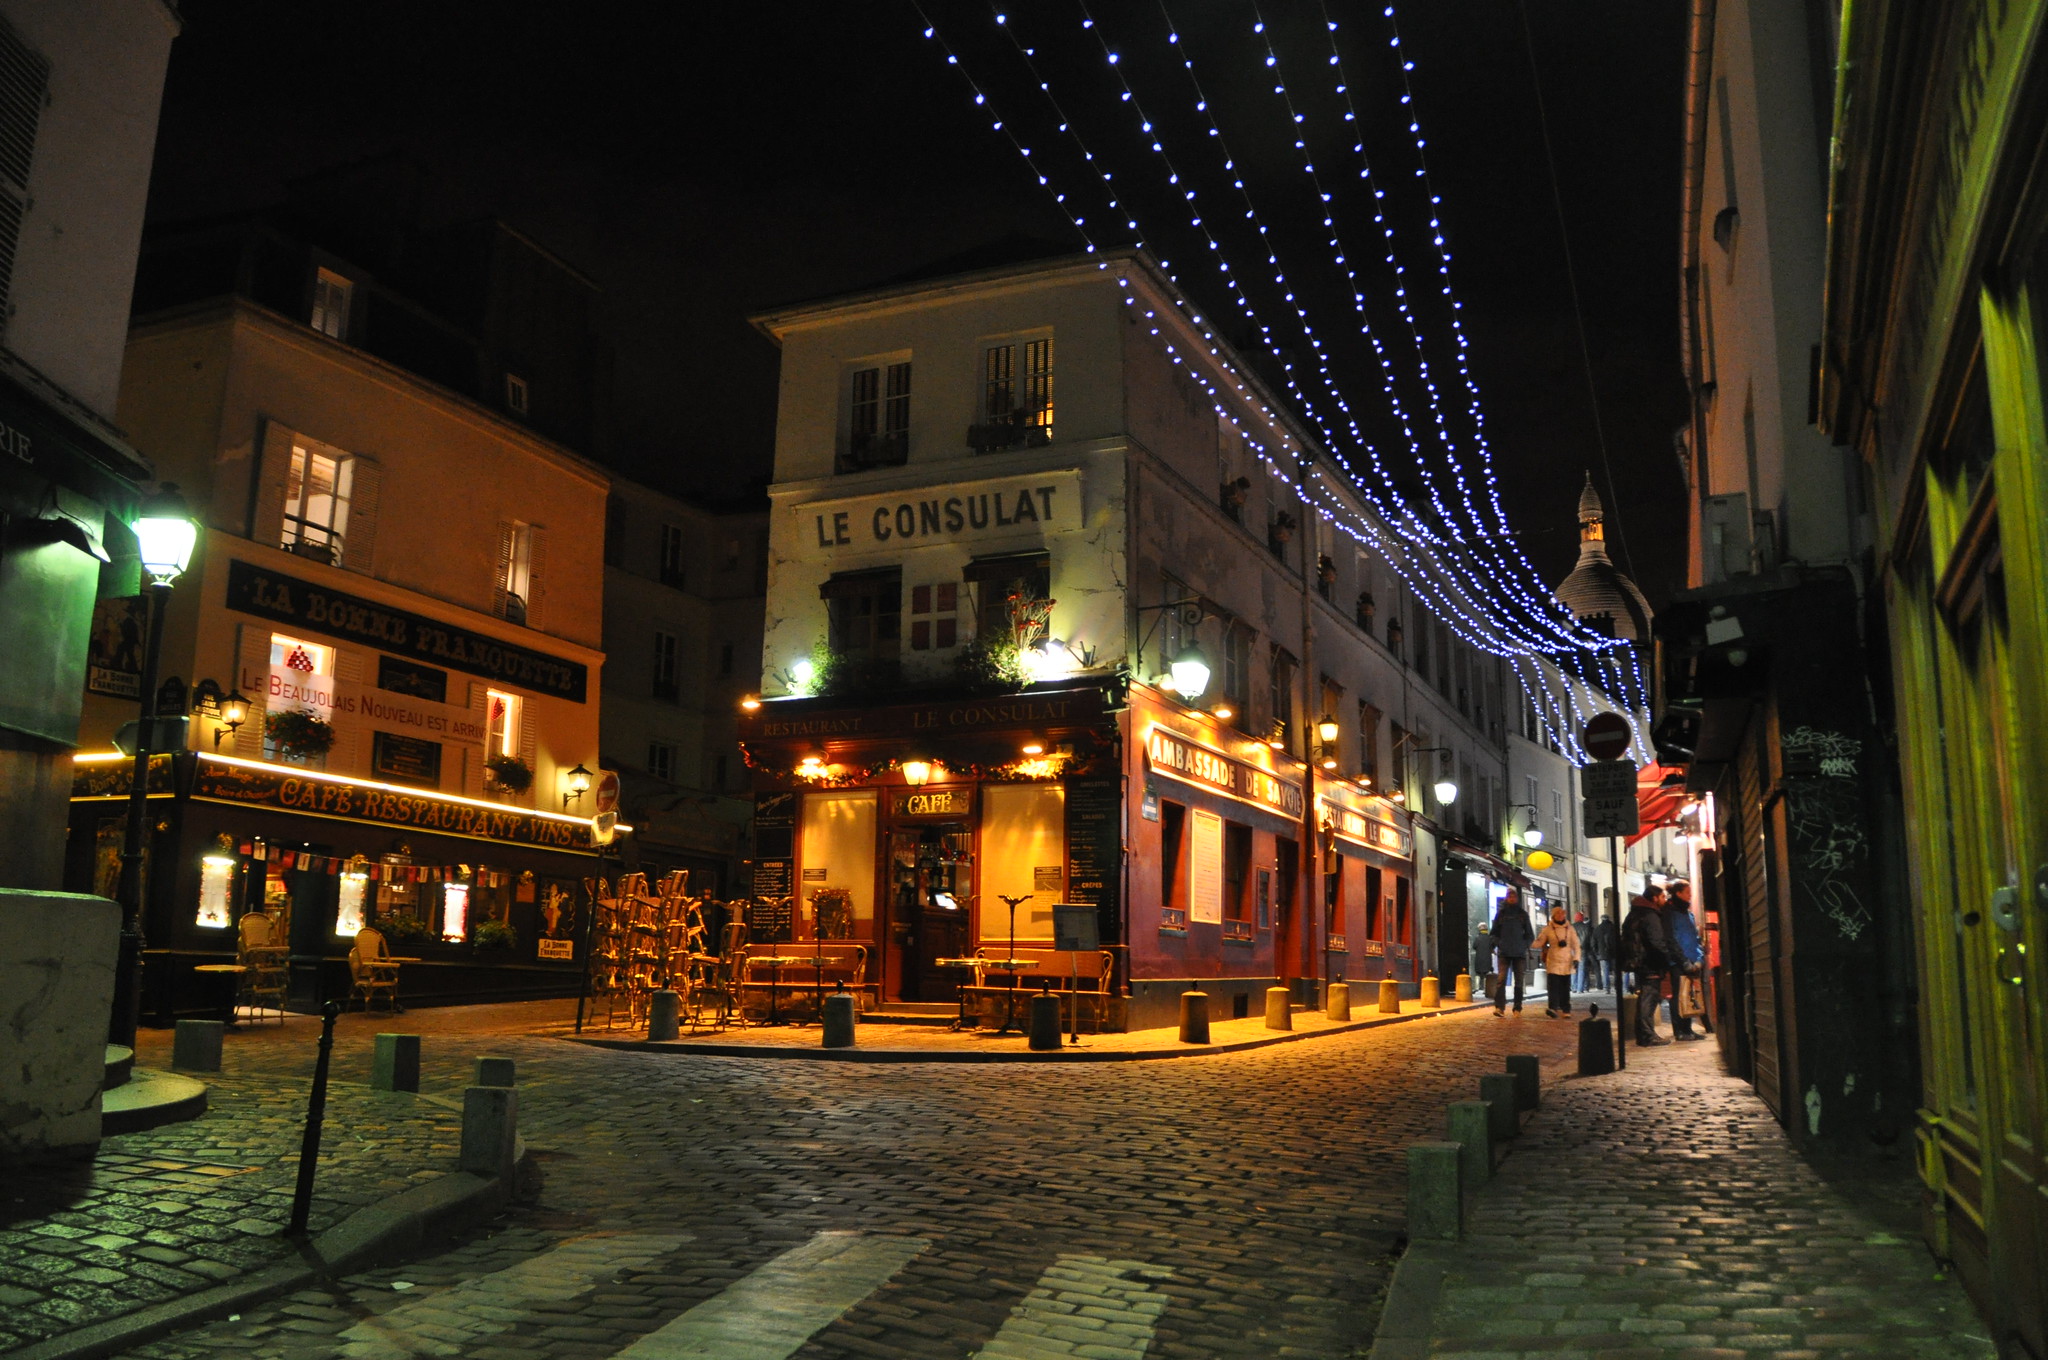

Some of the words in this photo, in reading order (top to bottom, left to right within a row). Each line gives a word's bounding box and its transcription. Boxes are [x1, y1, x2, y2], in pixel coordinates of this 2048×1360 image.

[816, 511, 851, 547] LE
[873, 486, 1056, 542] CONSULAT
[253, 576, 295, 615] LA
[307, 592, 408, 646] BONNE
[416, 624, 575, 692] FRANQUETTE
[360, 694, 424, 727] NOUVEAU
[764, 718, 862, 737] RESTAURANT
[913, 709, 940, 729] LE
[950, 701, 1071, 726] CONSULAT
[1151, 735, 1236, 789] AMBASSADE
[1245, 771, 1259, 797] DE
[1266, 779, 1301, 814] SAVOIE
[362, 790, 522, 840] RESTAURANT
[529, 818, 573, 846] VINS
[907, 792, 953, 814] CAFÉ
[1596, 799, 1624, 810] SAUF
[1369, 822, 1378, 841] LE
